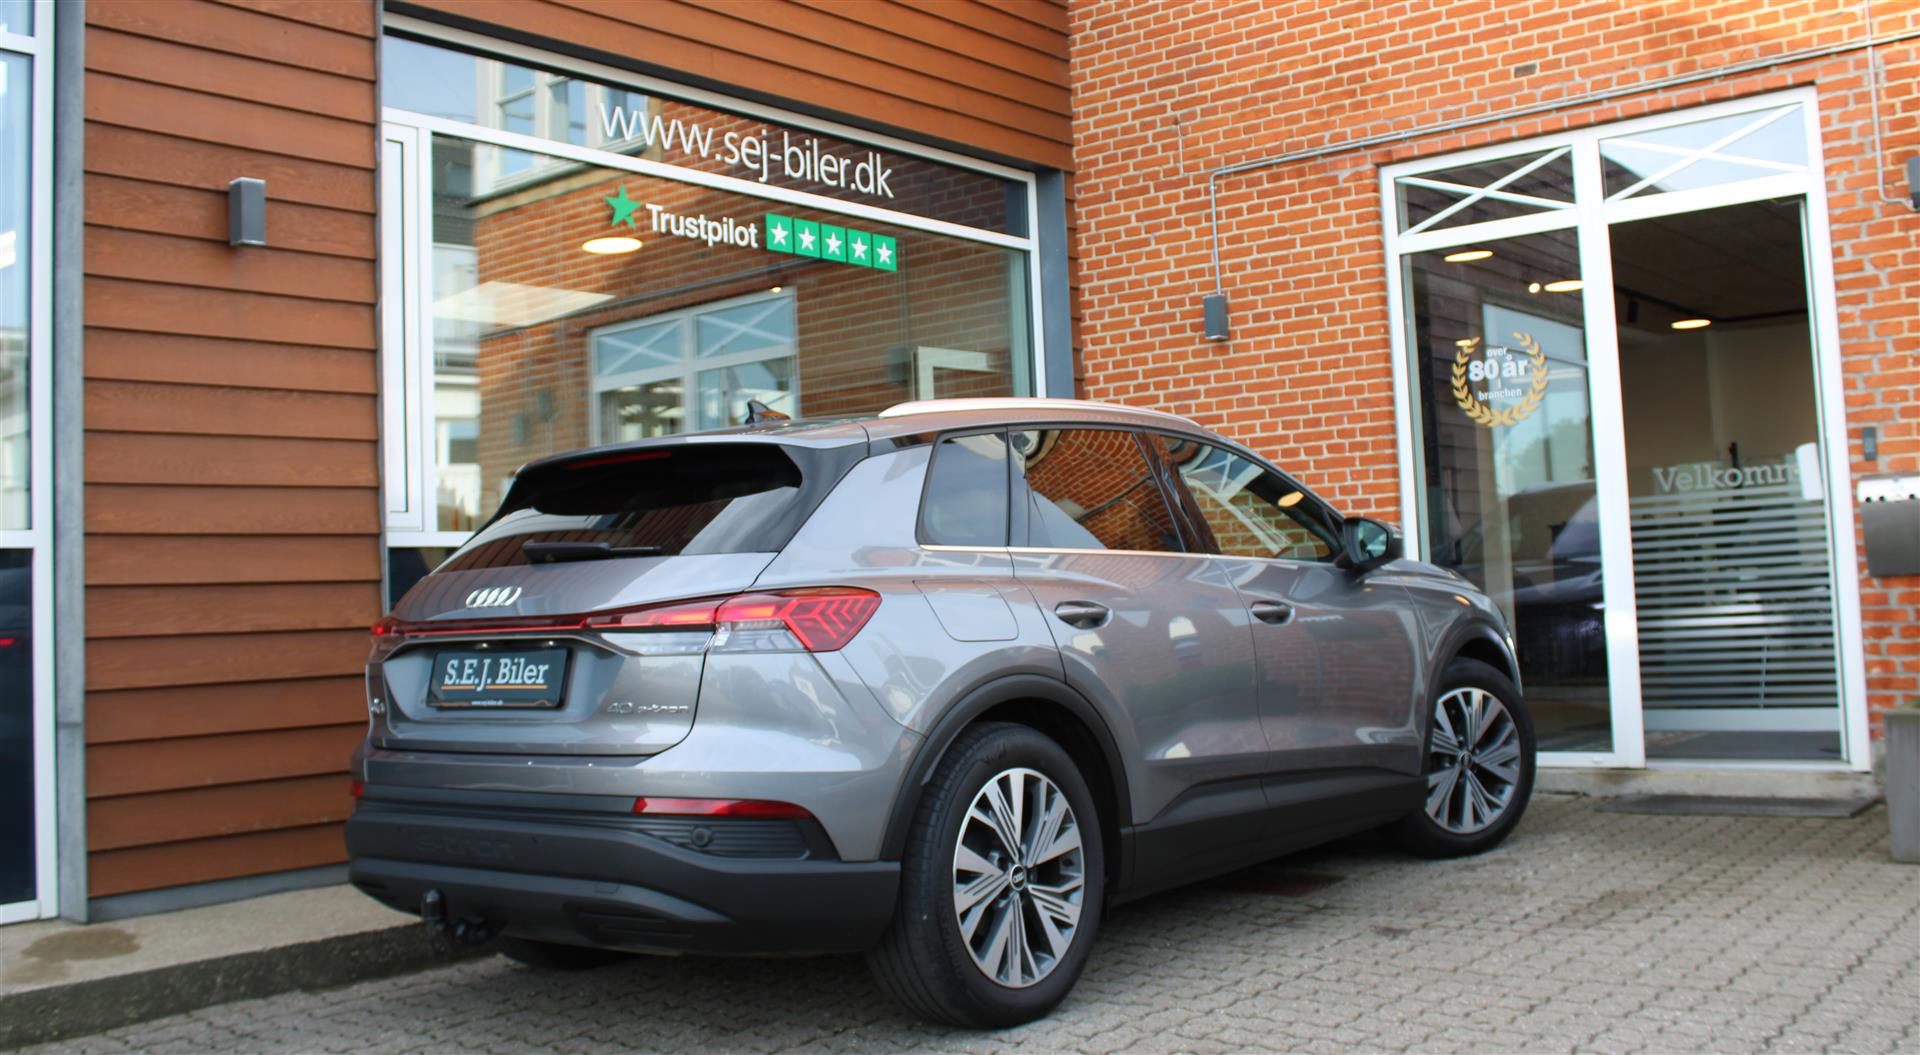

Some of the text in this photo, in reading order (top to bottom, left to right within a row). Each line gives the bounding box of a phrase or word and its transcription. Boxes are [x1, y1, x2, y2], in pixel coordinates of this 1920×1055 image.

[600, 102, 894, 199] www.sej-biler.dk
[645, 203, 759, 249] Trustpilot
[1468, 354, 1529, 382] 80 år
[1486, 346, 1507, 359] over
[1478, 387, 1522, 401] branchen
[443, 657, 549, 692] S.E.J. Biler
